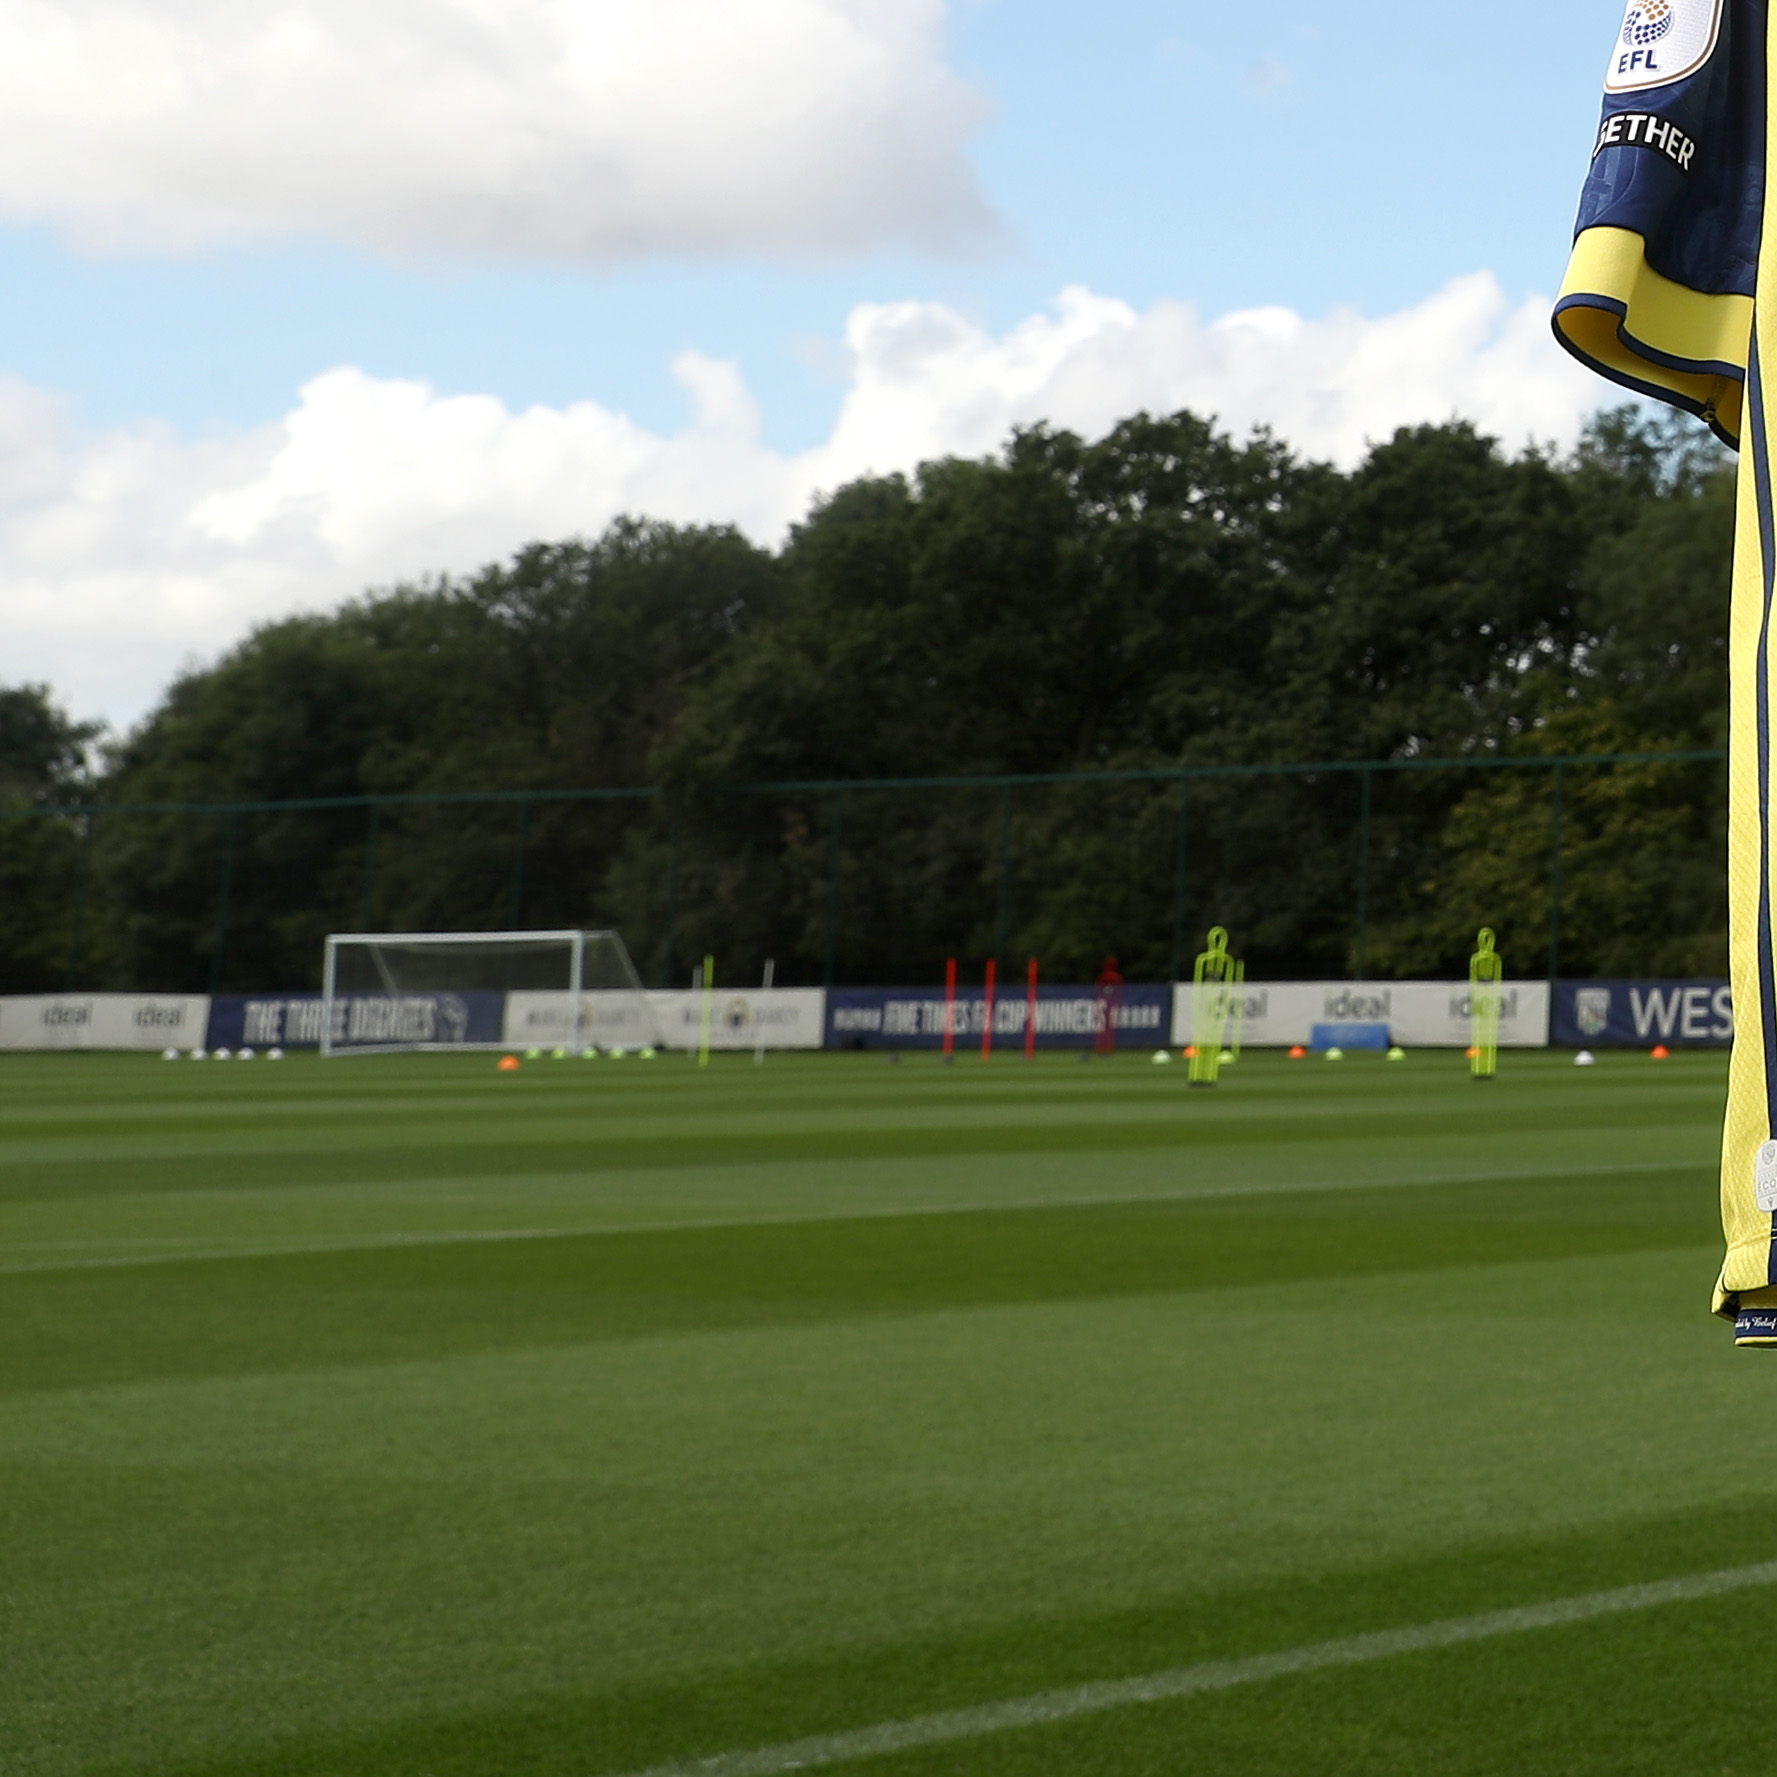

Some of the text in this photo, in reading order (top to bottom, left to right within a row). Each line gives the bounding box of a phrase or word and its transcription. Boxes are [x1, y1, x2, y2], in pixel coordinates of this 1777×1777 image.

[1617, 49, 1659, 75] EFL
[1325, 987, 1392, 1019] ideal
[1628, 986, 1734, 1039] WES
